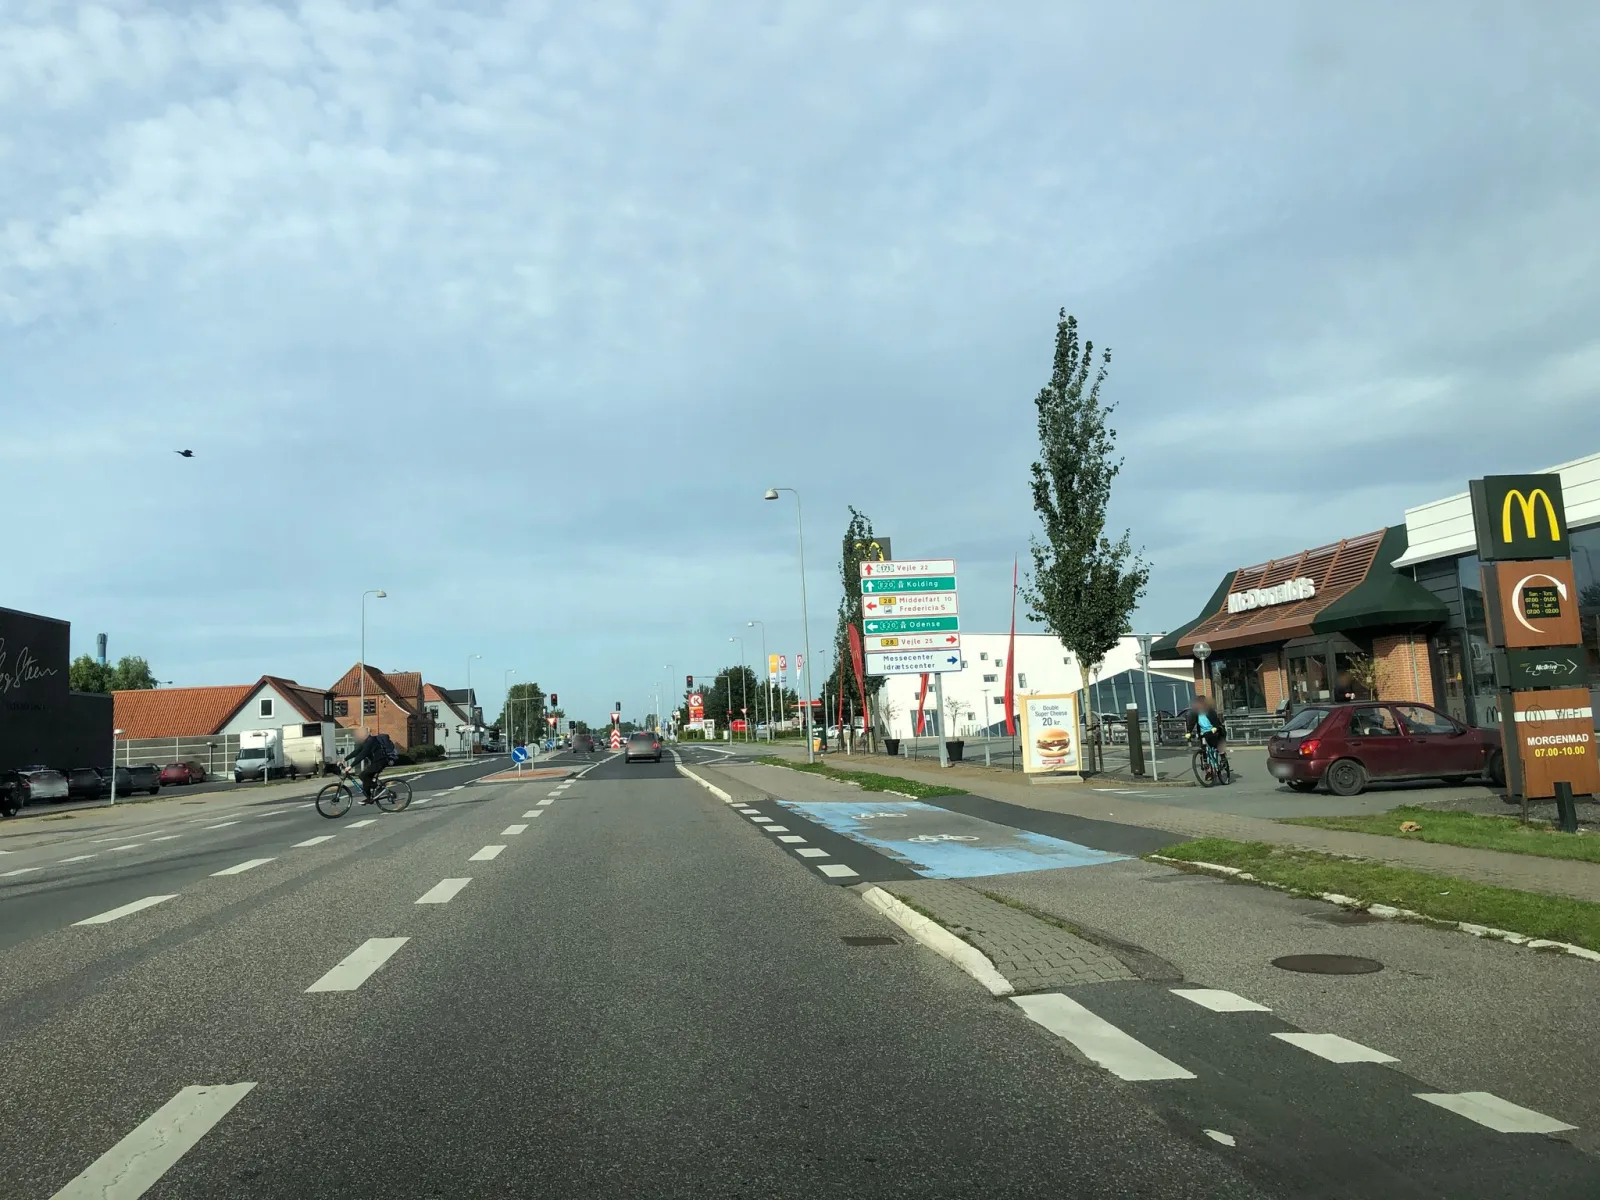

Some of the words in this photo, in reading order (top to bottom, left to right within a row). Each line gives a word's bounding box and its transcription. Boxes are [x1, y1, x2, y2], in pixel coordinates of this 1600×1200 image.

[879, 581, 895, 589] E20
[906, 580, 939, 588] Kolding
[899, 596, 940, 604] Middelfart
[1227, 577, 1316, 614] McDonald's
[901, 638, 921, 646] Vejle
[883, 654, 934, 662] Messecenter
[883, 663, 935, 671] Idrætscenter
[1042, 717, 1053, 726] 20
[1527, 733, 1589, 746] MORGENMAD
[1534, 745, 1586, 757] 07.00-10.00
